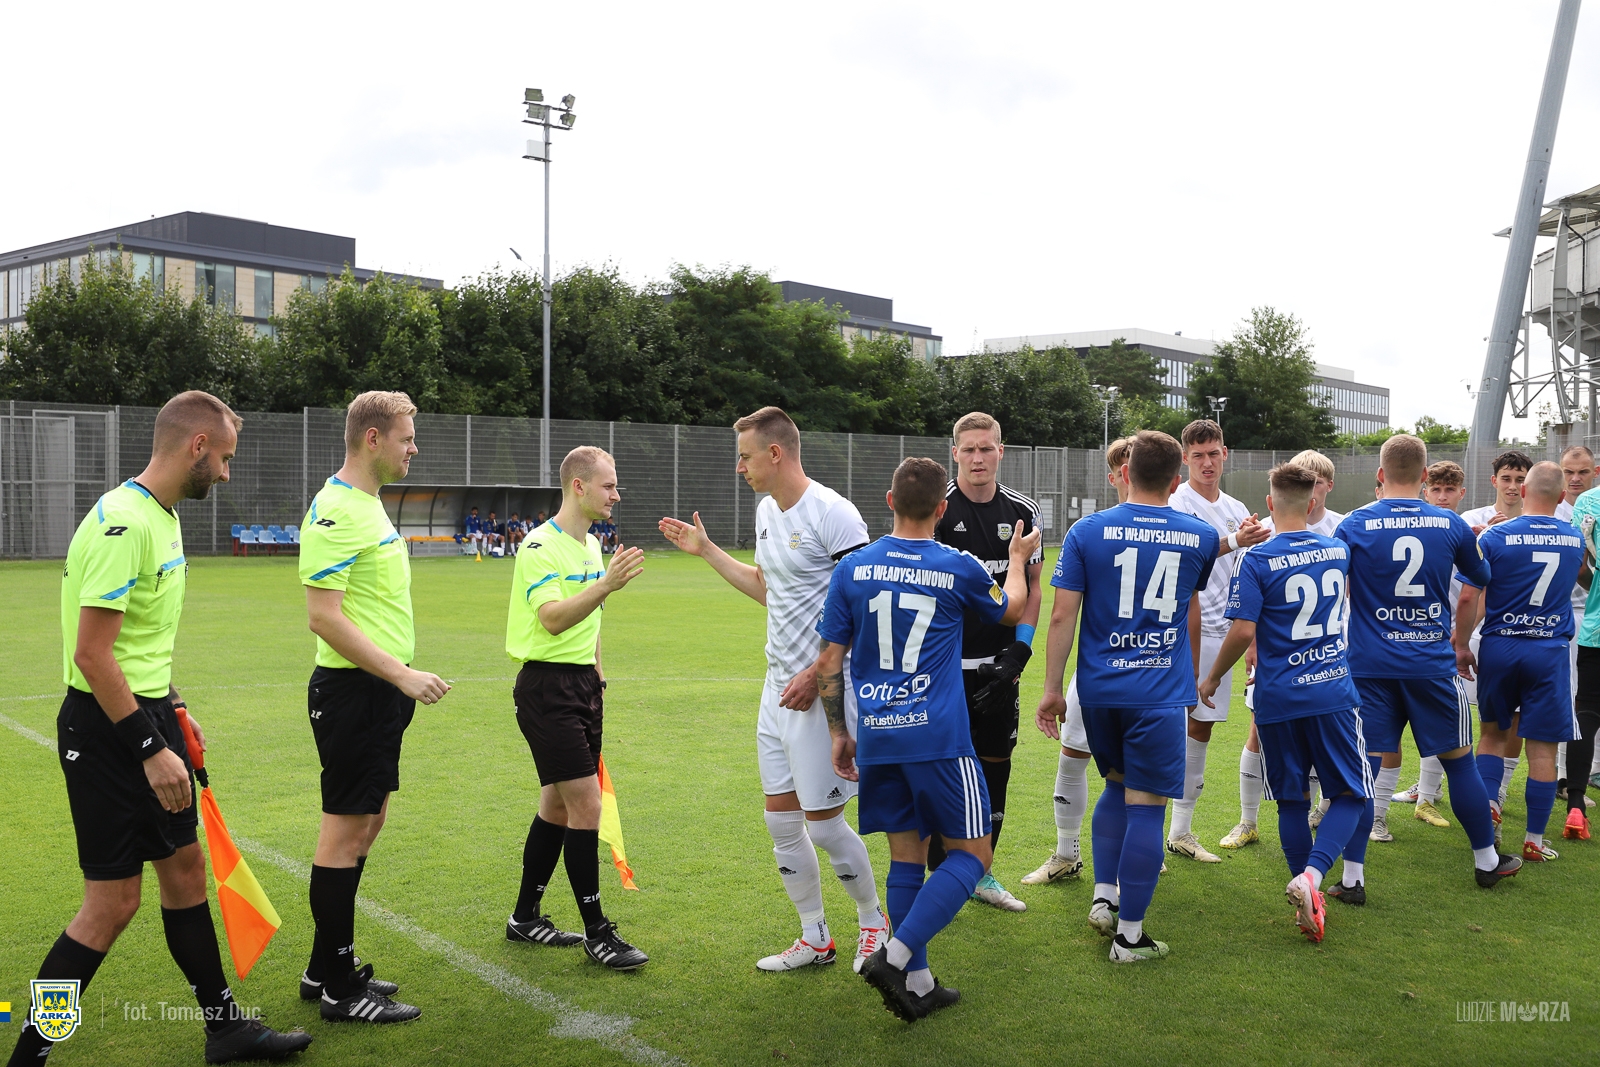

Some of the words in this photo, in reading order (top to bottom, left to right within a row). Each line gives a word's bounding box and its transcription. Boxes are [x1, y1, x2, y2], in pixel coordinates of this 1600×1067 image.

[1365, 519, 1383, 531] MKS
[1383, 516, 1451, 530] WŁADYSŁAWOWO
[1103, 526, 1124, 541] MKS
[1124, 527, 1200, 549] WŁADYSŁAWOWO
[1505, 534, 1523, 546] MKS
[1268, 555, 1289, 572] MKS
[1286, 547, 1347, 567] WŁADYSŁAWOW
[1392, 535, 1426, 597] 2
[853, 565, 873, 582] MKS
[873, 565, 955, 590] WŁADYSŁAWOWO
[1113, 546, 1182, 624] 14
[1529, 551, 1561, 607] 7
[1285, 568, 1346, 641] 22
[1376, 605, 1428, 622] ortus
[868, 590, 937, 674] 17
[863, 709, 929, 727] eTrustMedical
